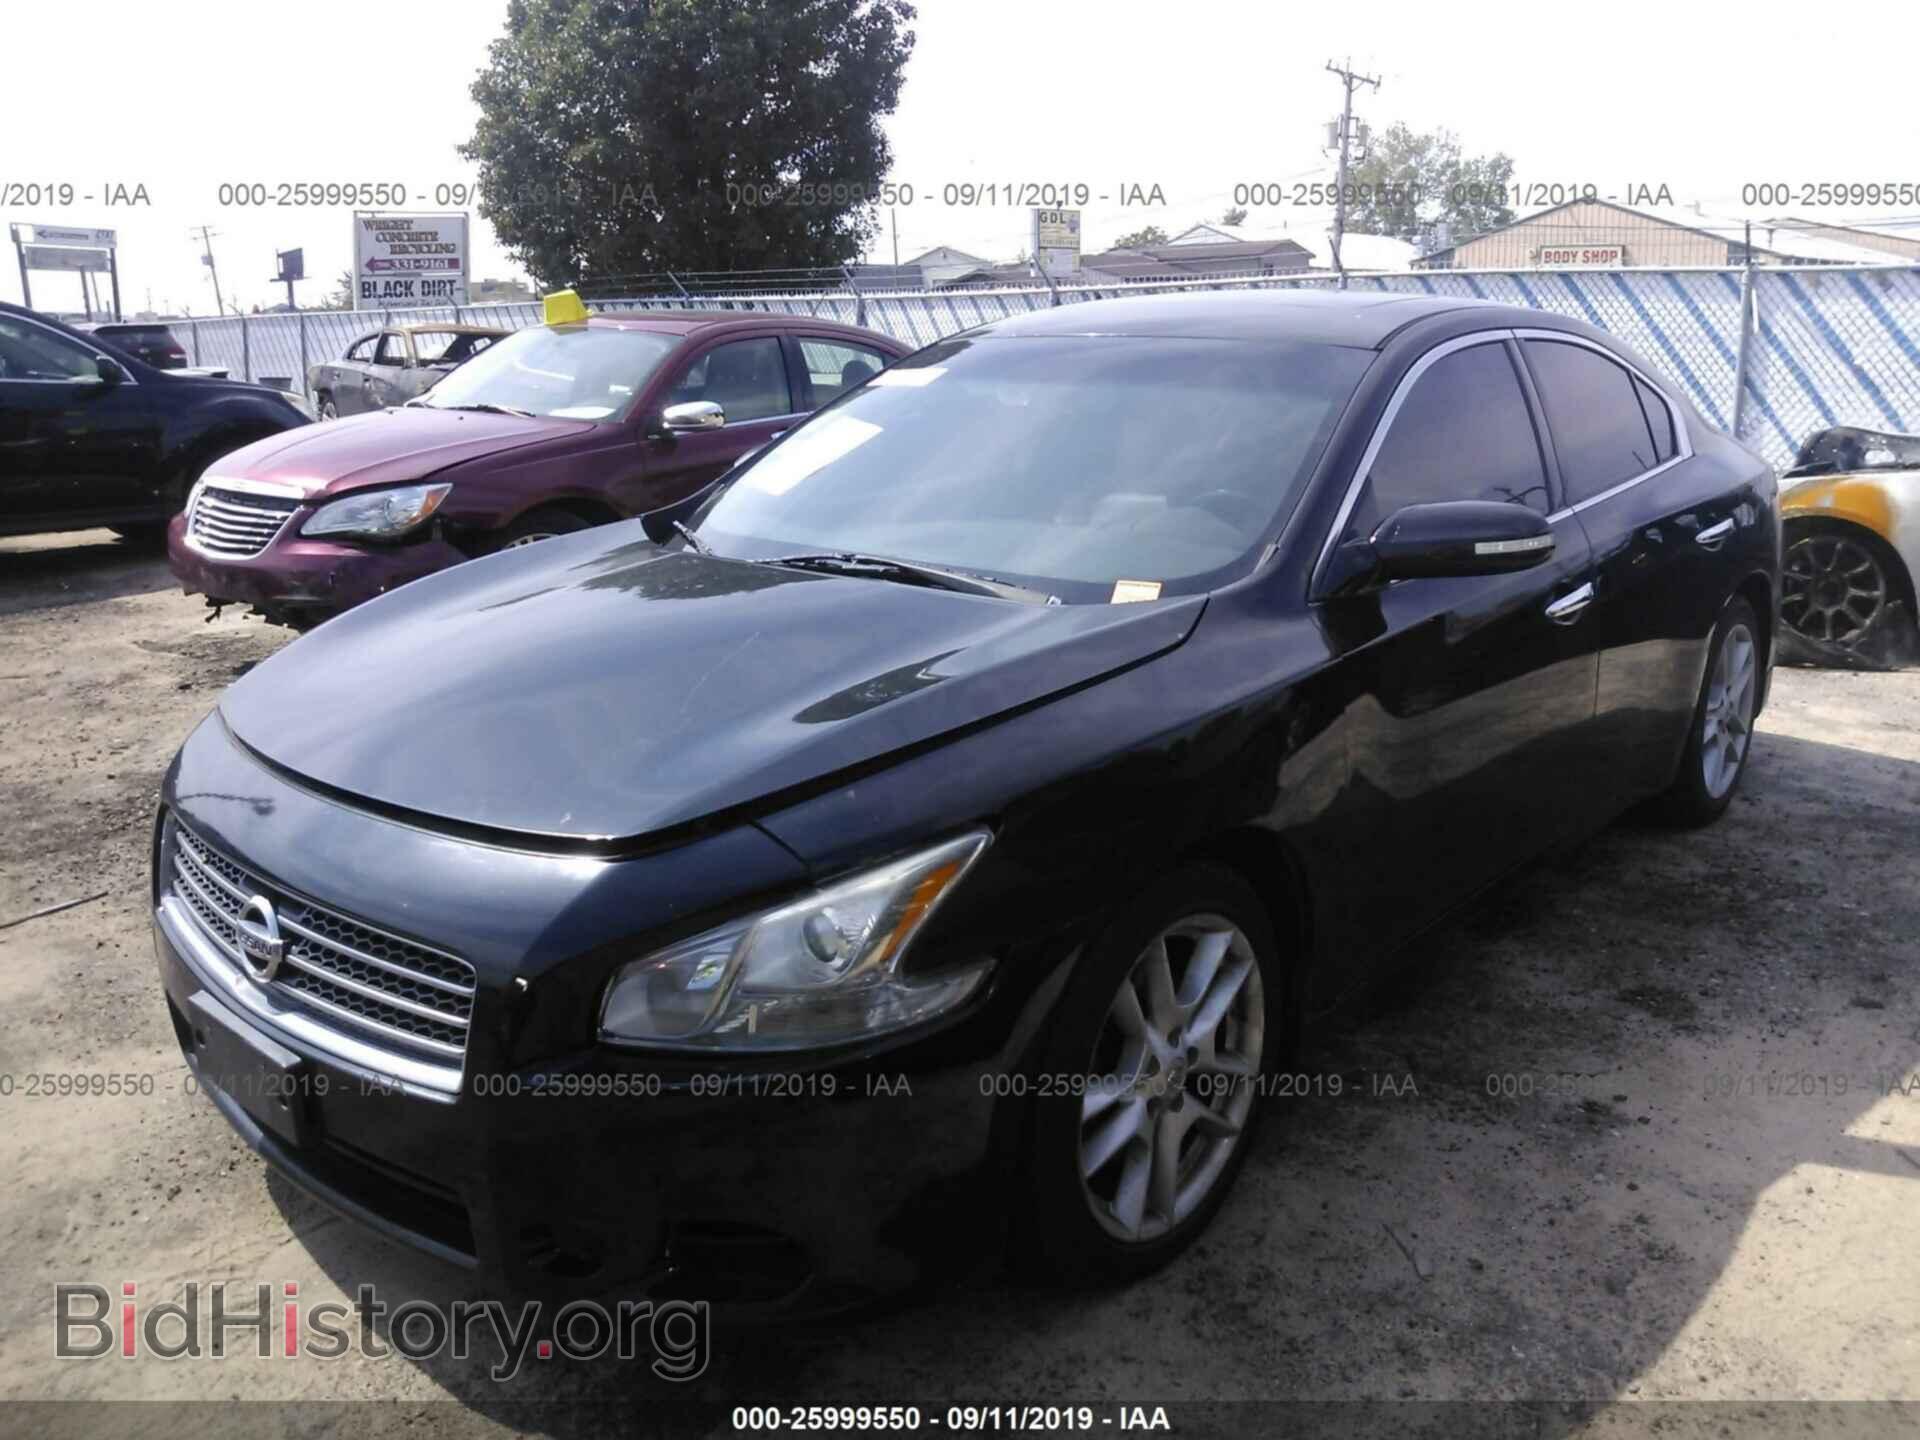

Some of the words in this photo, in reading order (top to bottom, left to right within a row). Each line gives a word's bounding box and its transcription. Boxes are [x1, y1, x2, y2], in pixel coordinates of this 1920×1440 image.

[1543, 249, 1578, 264] BODY
[1582, 249, 1618, 264] SHOP
[361, 281, 415, 299] BLACK
[421, 280, 456, 297] DIRT
